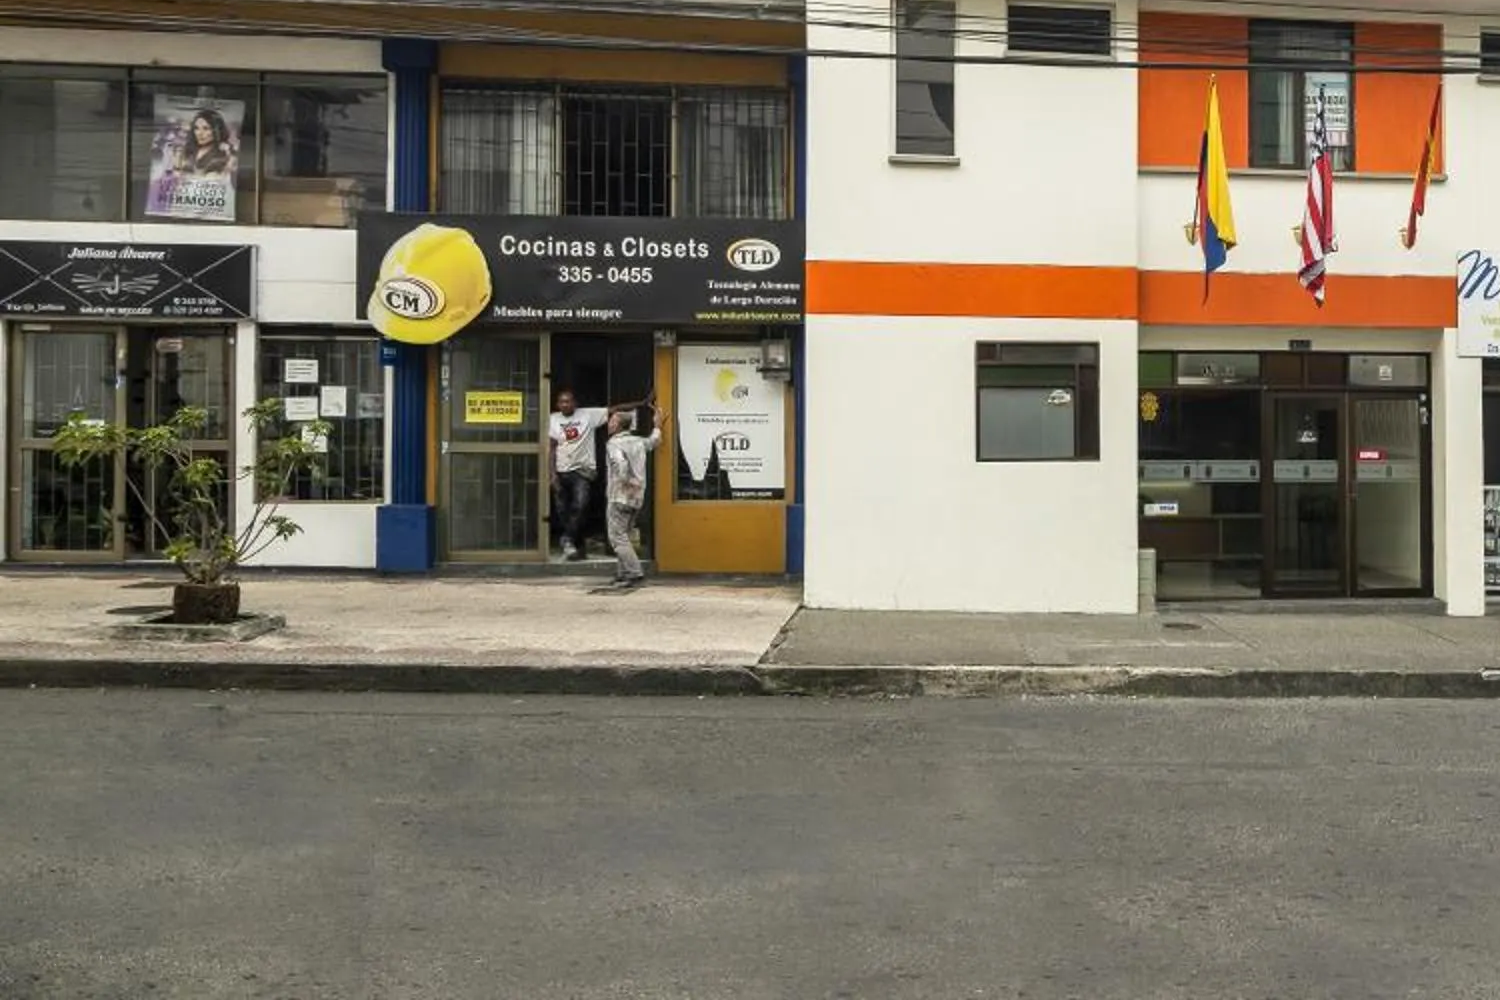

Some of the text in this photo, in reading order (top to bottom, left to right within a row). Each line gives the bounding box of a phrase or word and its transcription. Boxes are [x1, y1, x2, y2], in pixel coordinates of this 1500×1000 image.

[67, 247, 117, 260] Juliana
[500, 235, 710, 259] Cocinas & Closets
[739, 249, 774, 265] TLD
[558, 265, 593, 284] 335
[607, 266, 653, 284] 0455
[385, 290, 421, 313] CM
[545, 308, 573, 320] para
[721, 437, 751, 451] TLD
